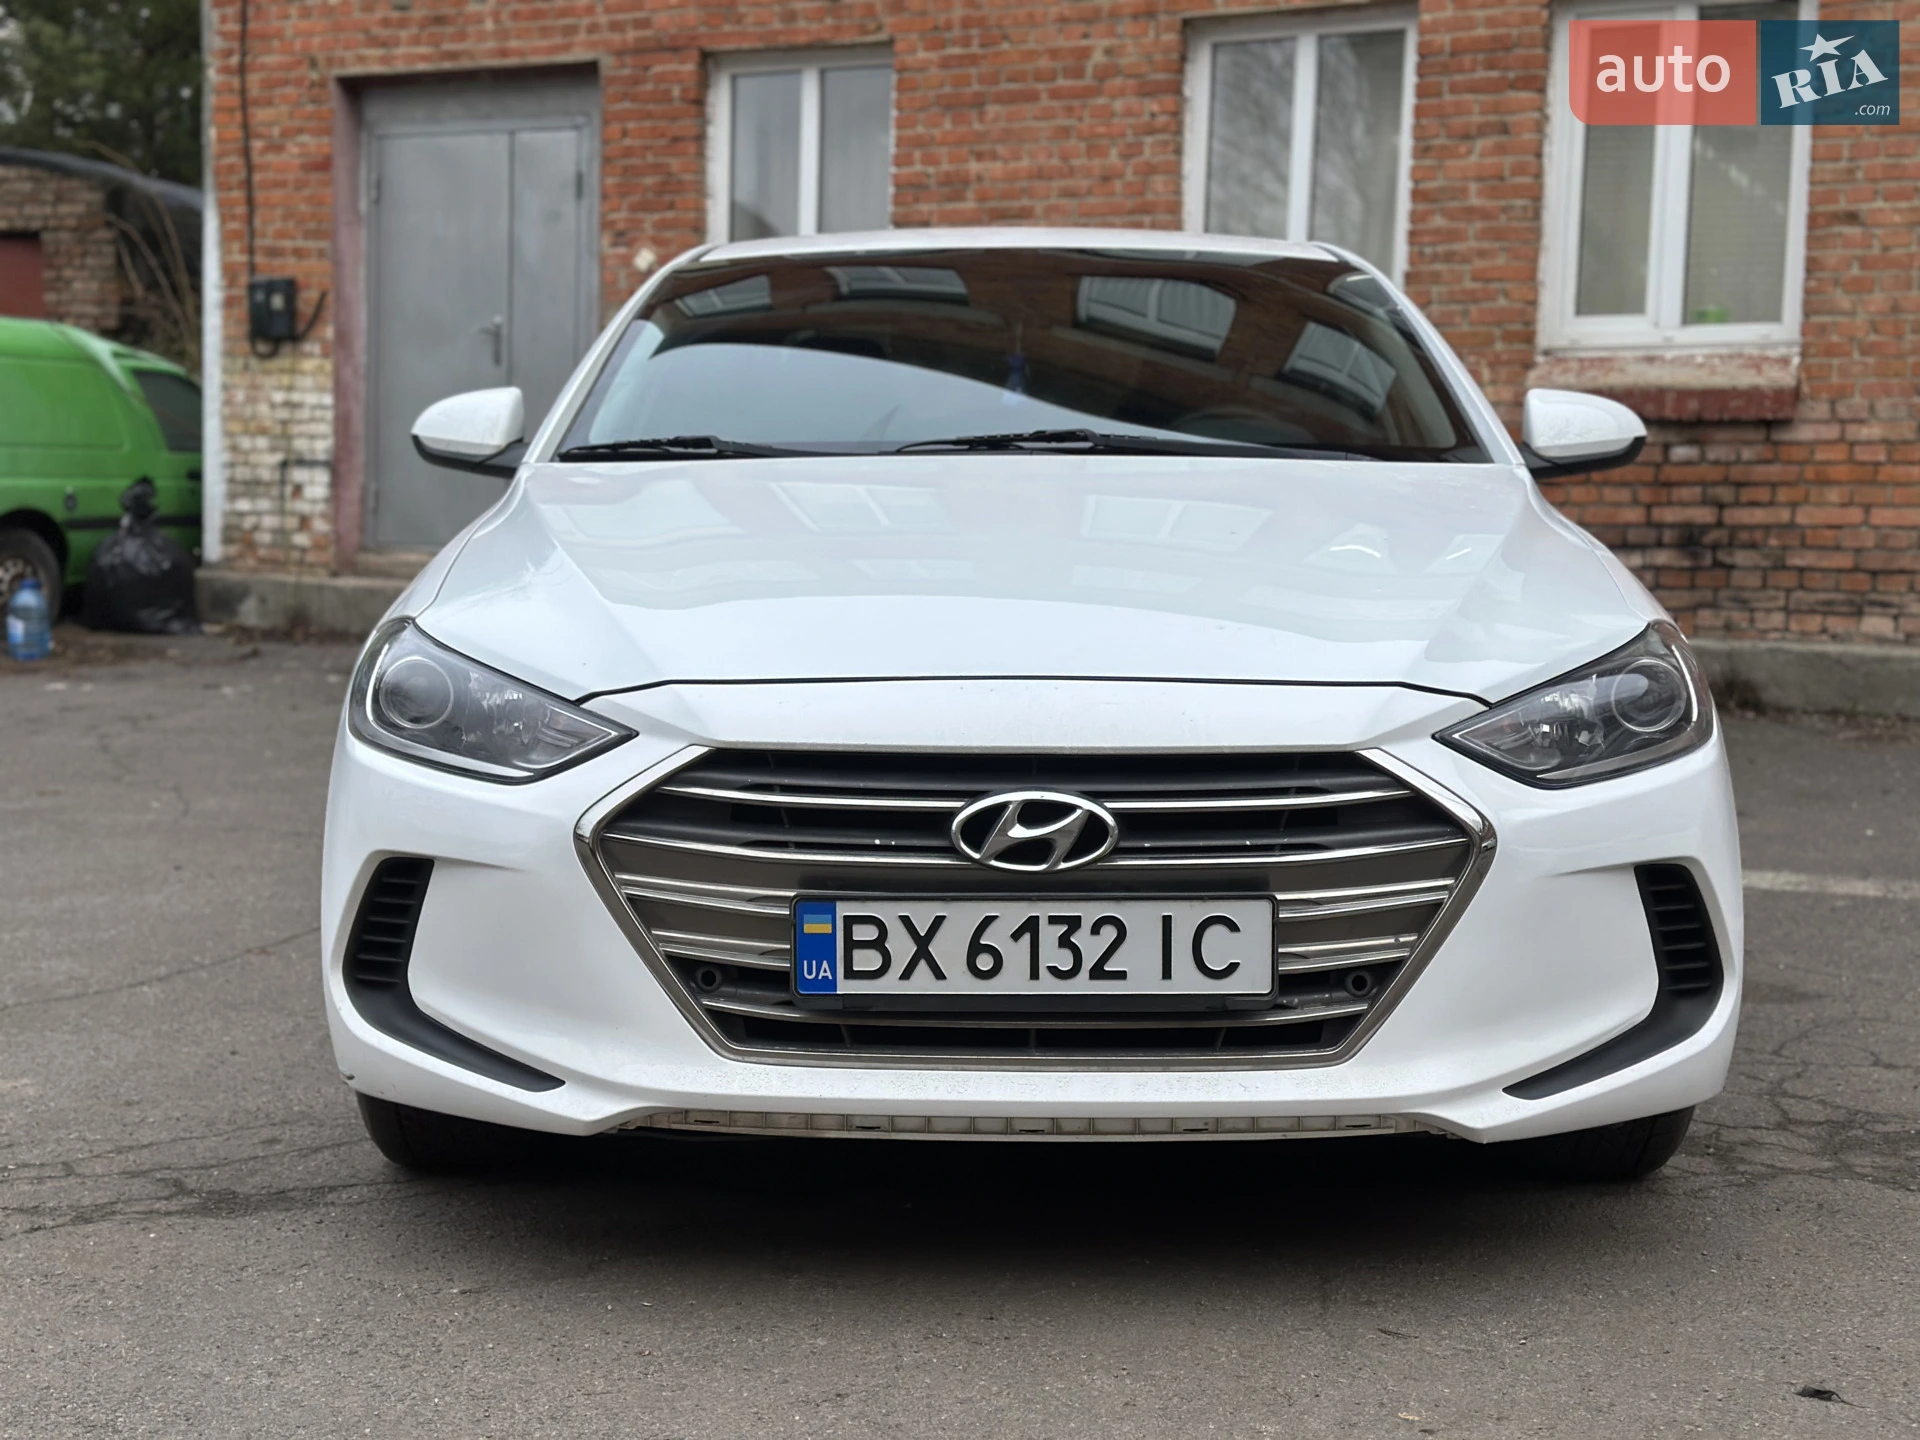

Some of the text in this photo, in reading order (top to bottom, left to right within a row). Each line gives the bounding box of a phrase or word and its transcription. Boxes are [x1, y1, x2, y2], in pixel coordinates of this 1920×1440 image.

[842, 914, 1242, 980] BX 6132 IC
[803, 960, 833, 980] UA
